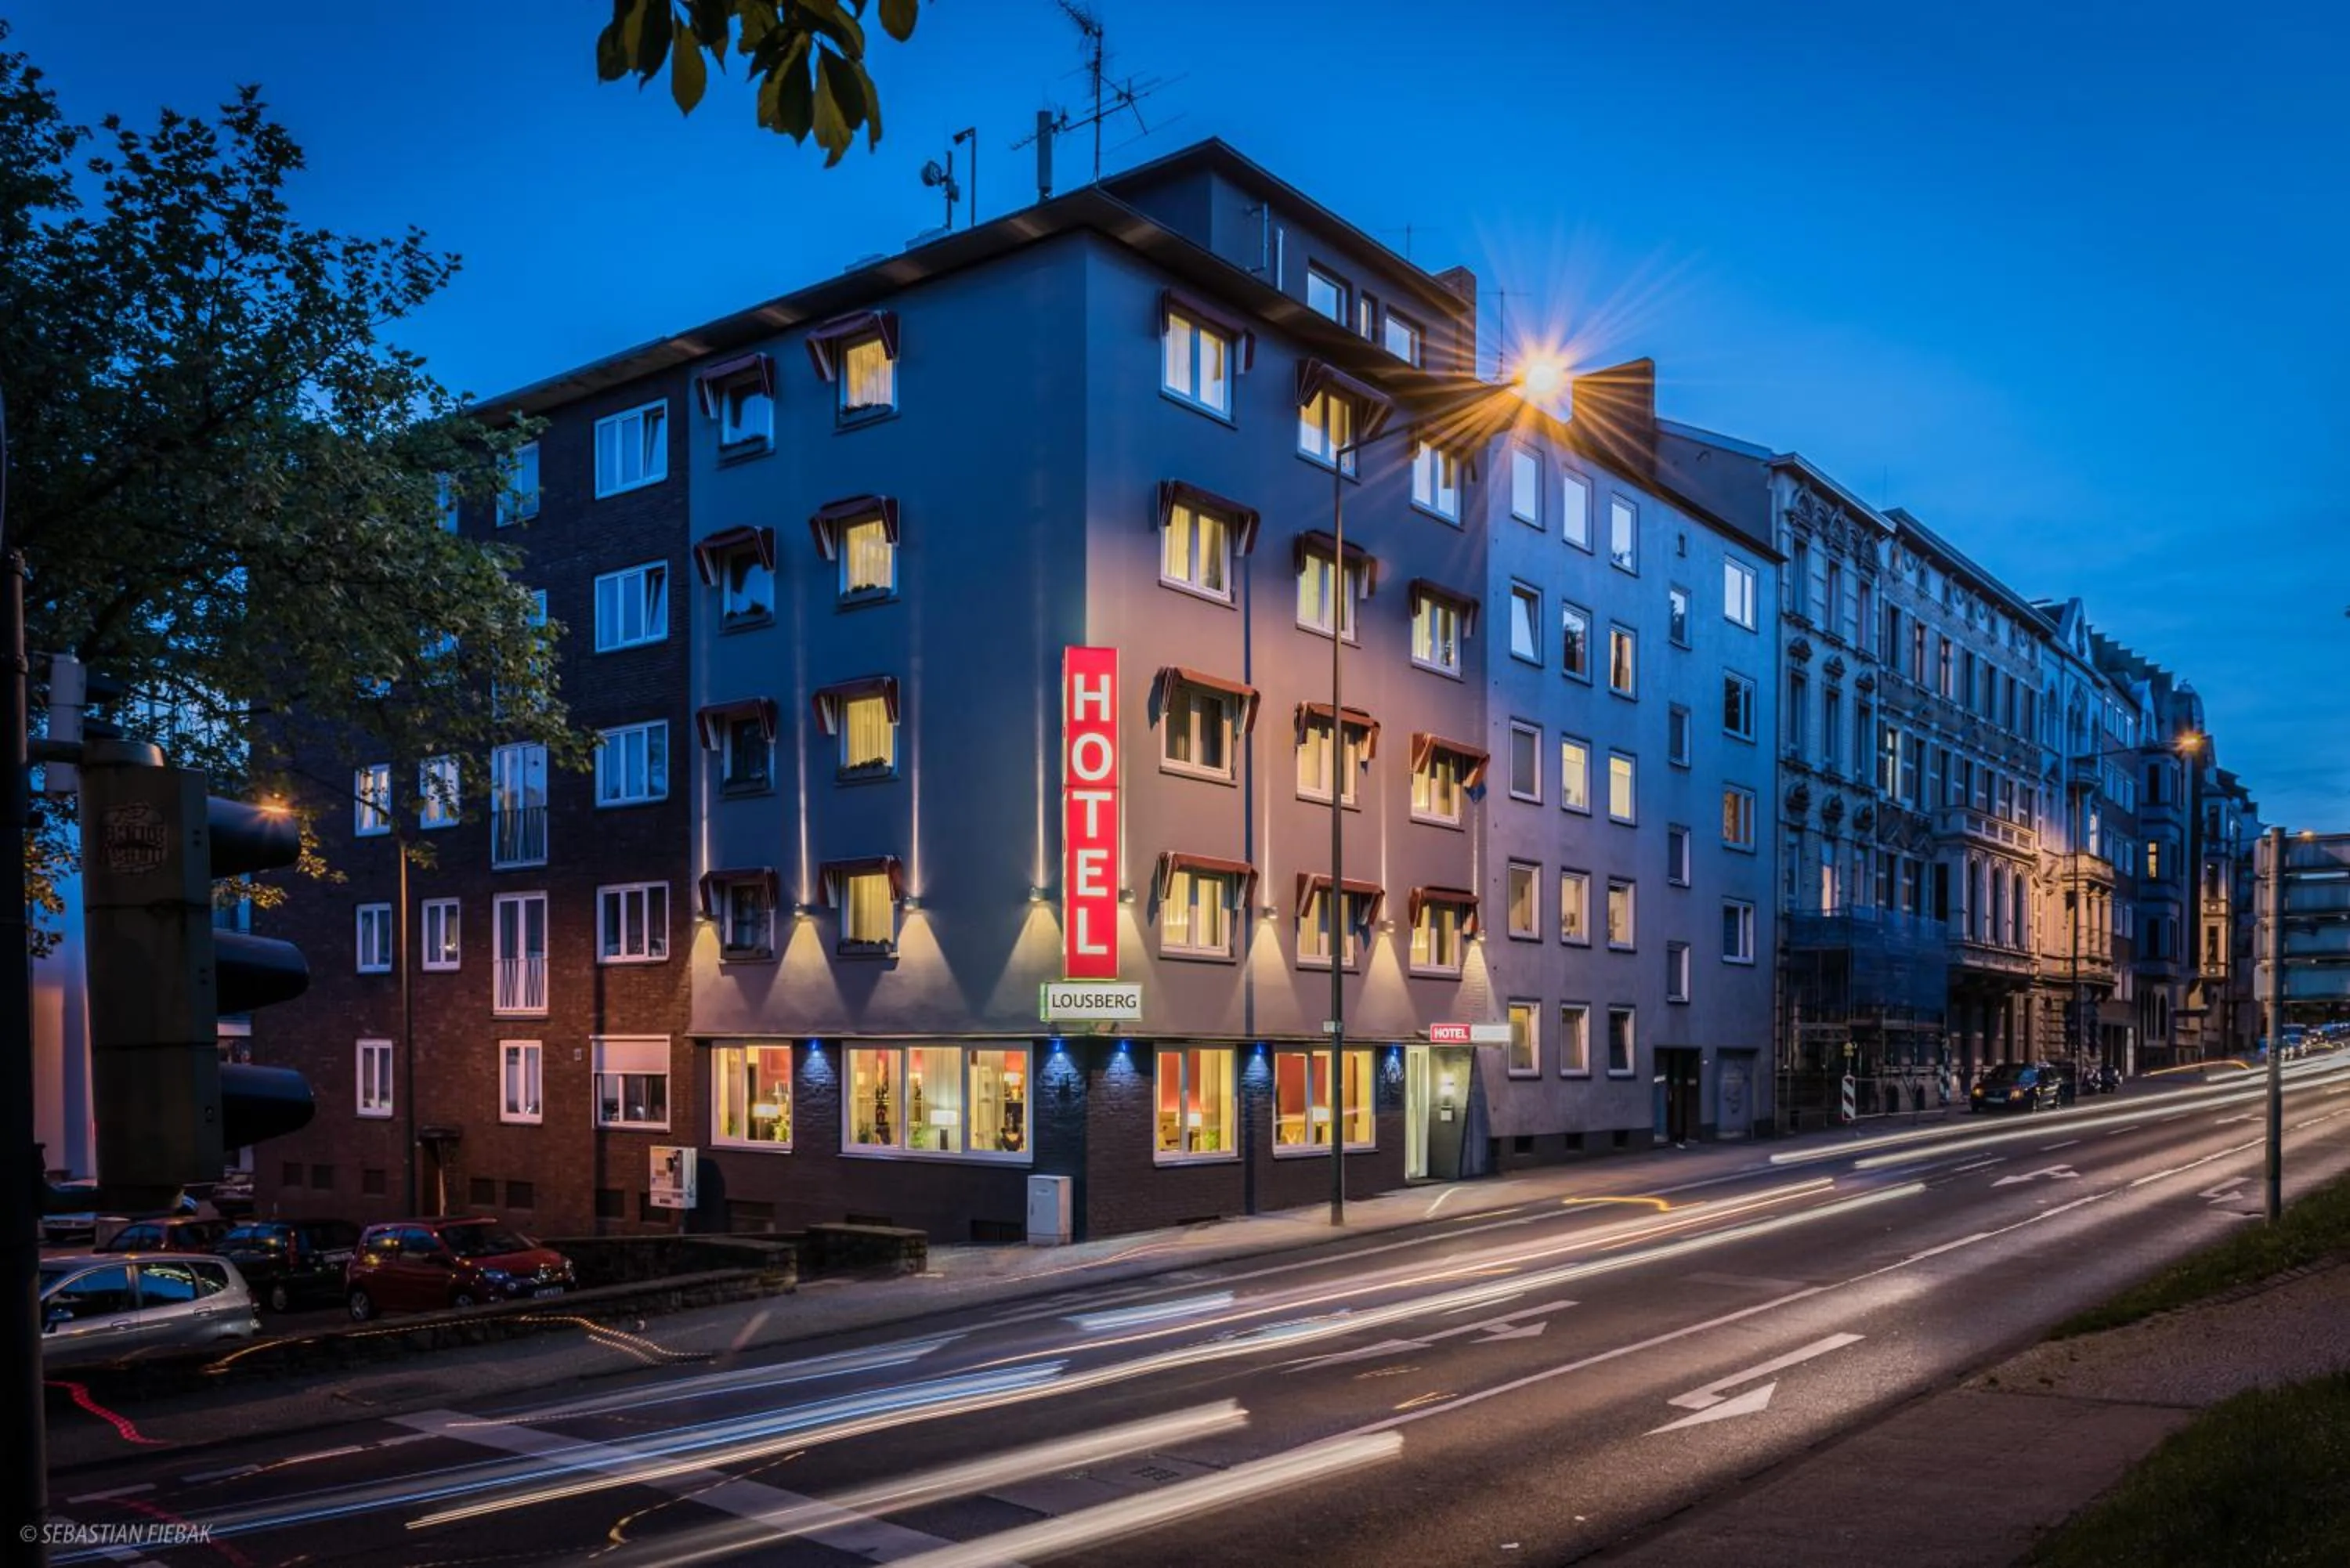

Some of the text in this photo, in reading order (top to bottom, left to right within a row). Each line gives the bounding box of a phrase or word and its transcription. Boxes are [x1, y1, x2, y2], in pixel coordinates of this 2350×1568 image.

[1072, 674, 1113, 955] HOTEL
[1052, 994, 1137, 1009] LOUSBERG
[1434, 1027, 1468, 1039] HOTEL
